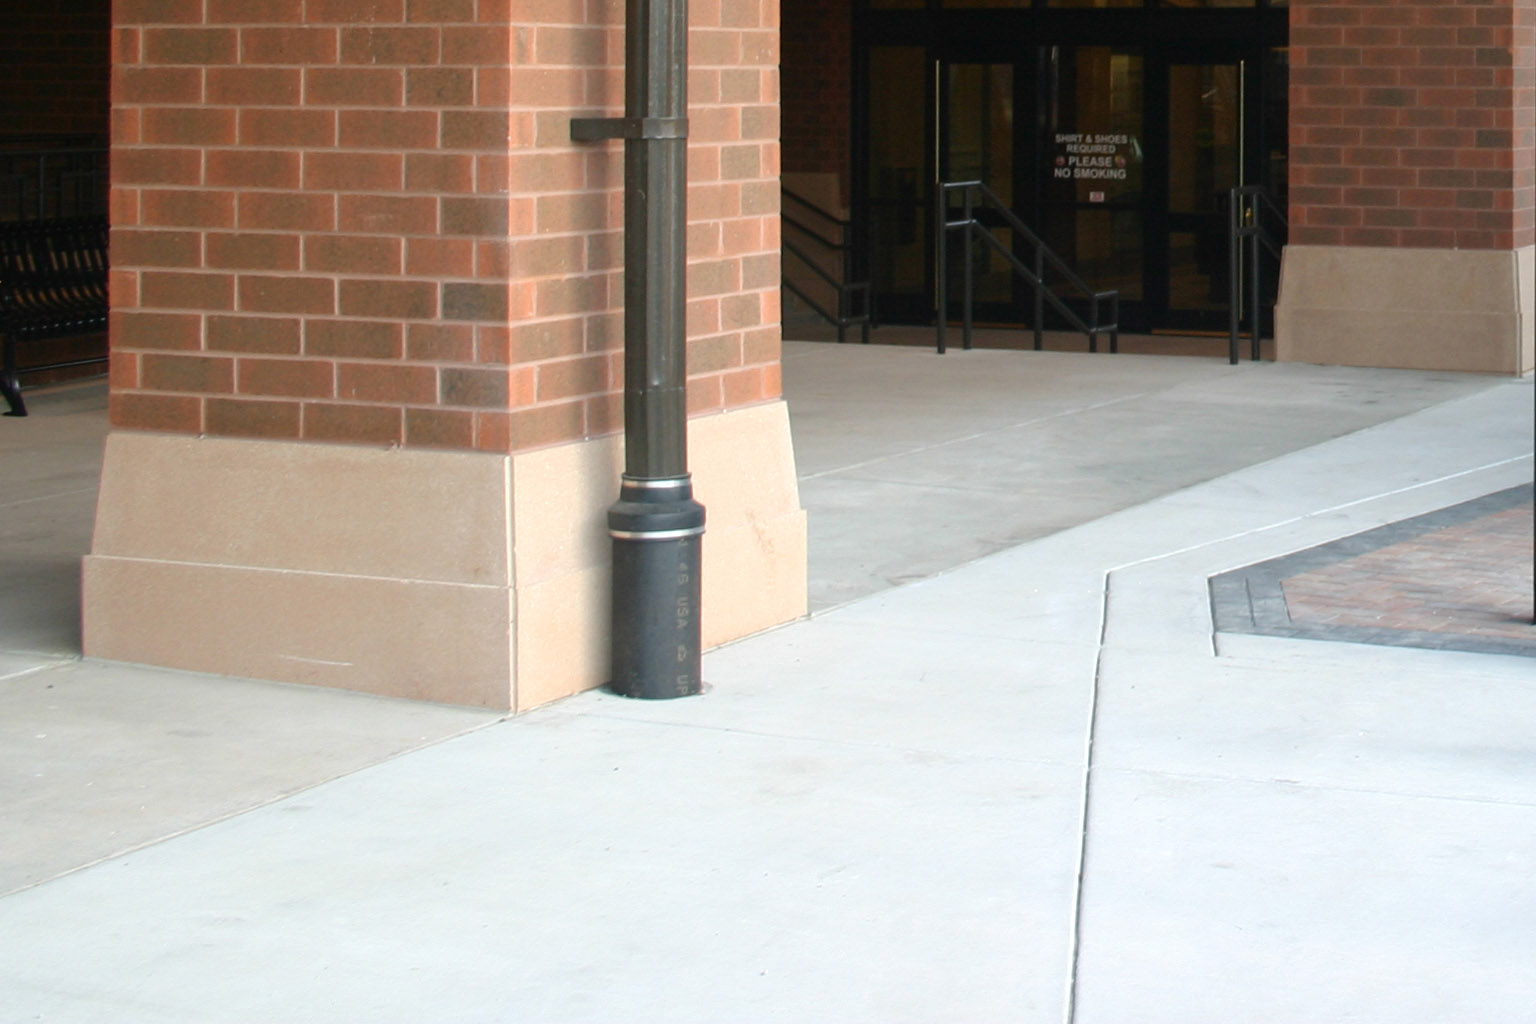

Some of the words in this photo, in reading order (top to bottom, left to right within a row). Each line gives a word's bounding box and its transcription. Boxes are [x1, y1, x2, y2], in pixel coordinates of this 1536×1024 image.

[1055, 134, 1083, 144] SHIRT
[1085, 135, 1093, 144] &
[1094, 135, 1128, 144] SHOES
[1066, 144, 1116, 154] REQUIRED
[1068, 156, 1113, 167] PLEASE
[1054, 168, 1071, 178] NO
[1073, 168, 1127, 179] SMOKING
